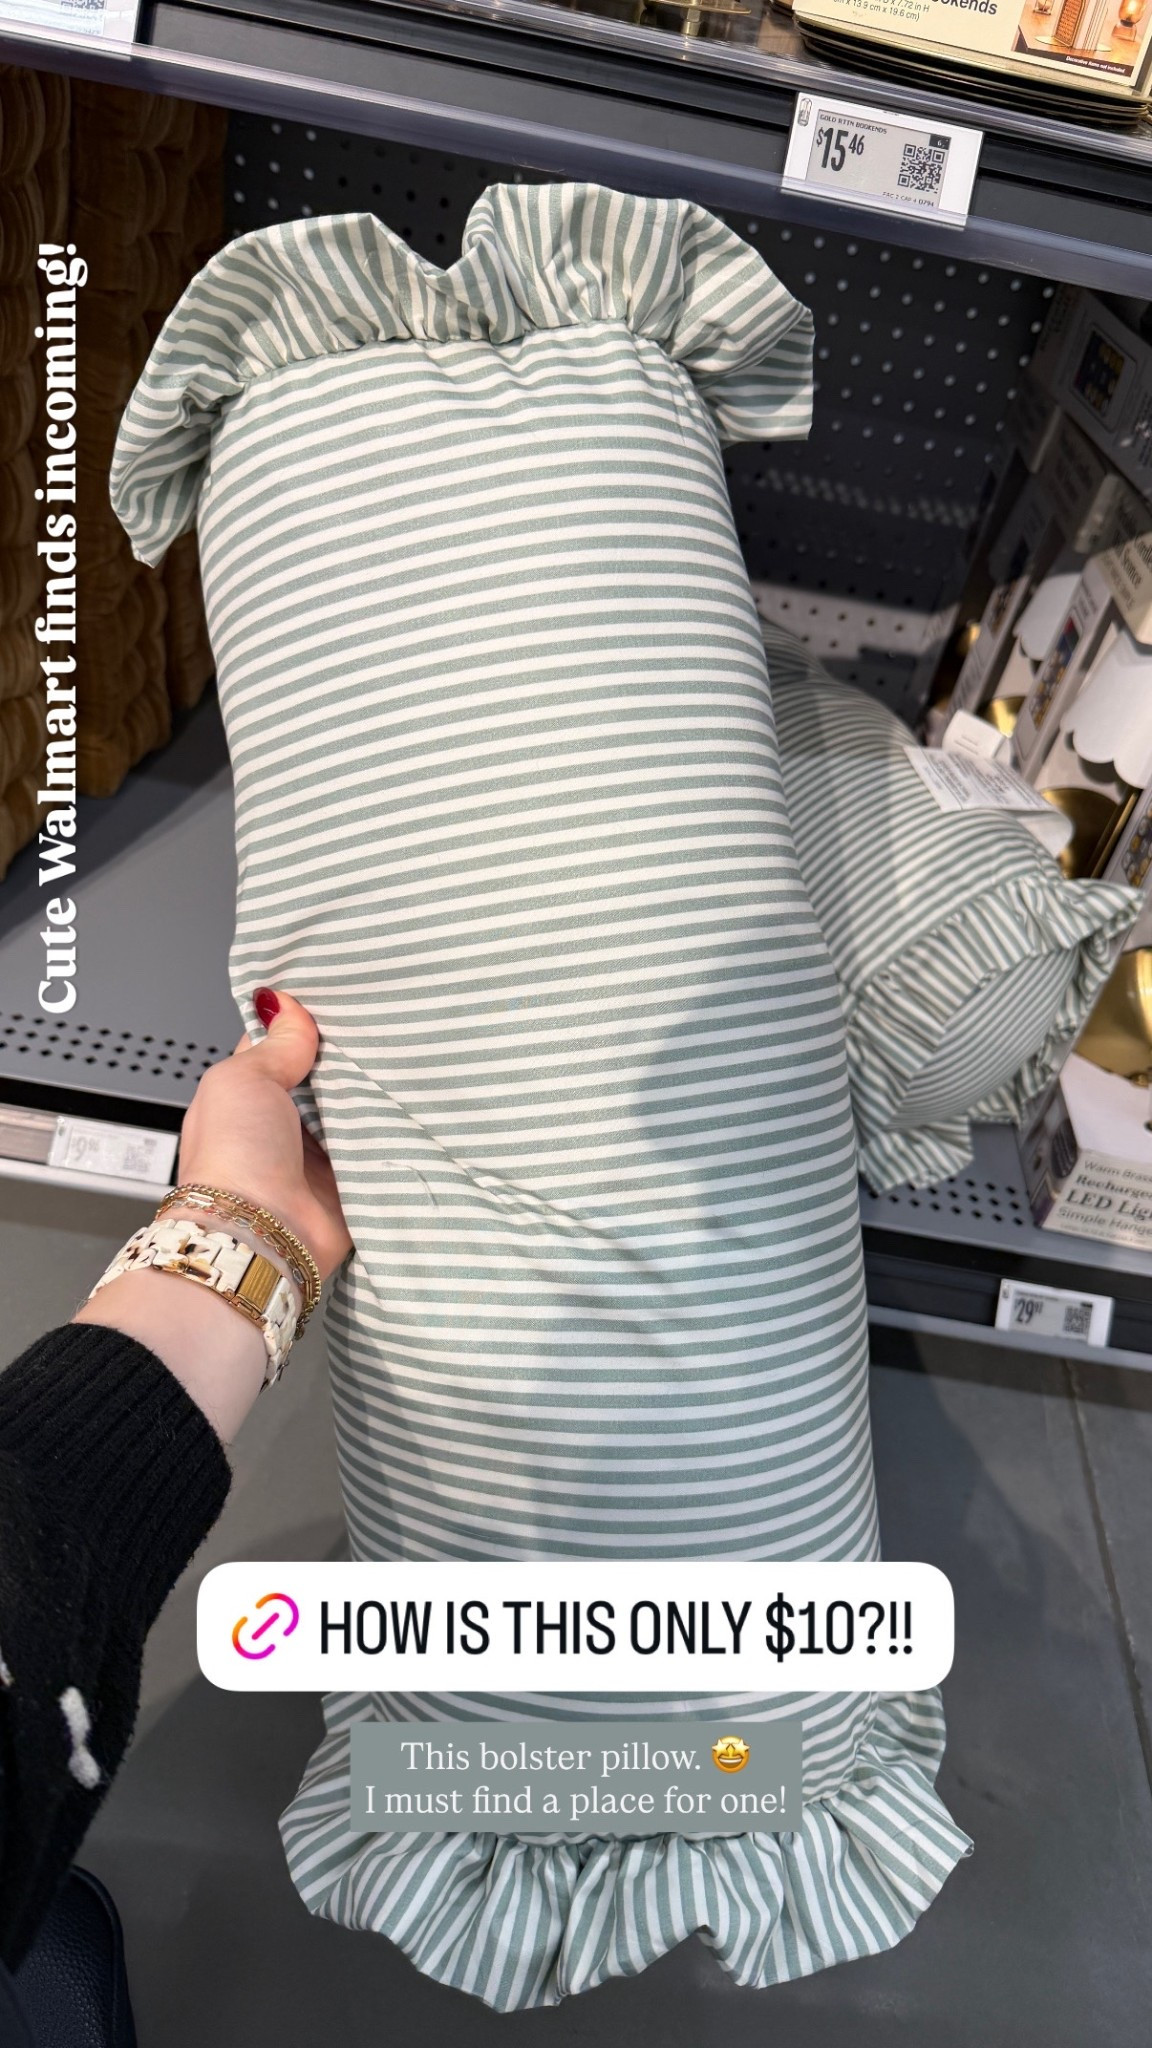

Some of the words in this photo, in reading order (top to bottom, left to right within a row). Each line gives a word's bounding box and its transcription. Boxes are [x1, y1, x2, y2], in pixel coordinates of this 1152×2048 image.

[869, 3, 881, 12] cm
[889, 7, 906, 17] 19.6
[914, 3, 922, 11] in
[923, 4, 930, 13] H
[820, 113, 837, 123] GOLD
[838, 117, 855, 127] RTTN
[855, 121, 888, 134] BOOKENDS
[1066, 1189, 1112, 1209] LED
[1059, 1206, 1106, 1225] Simple
